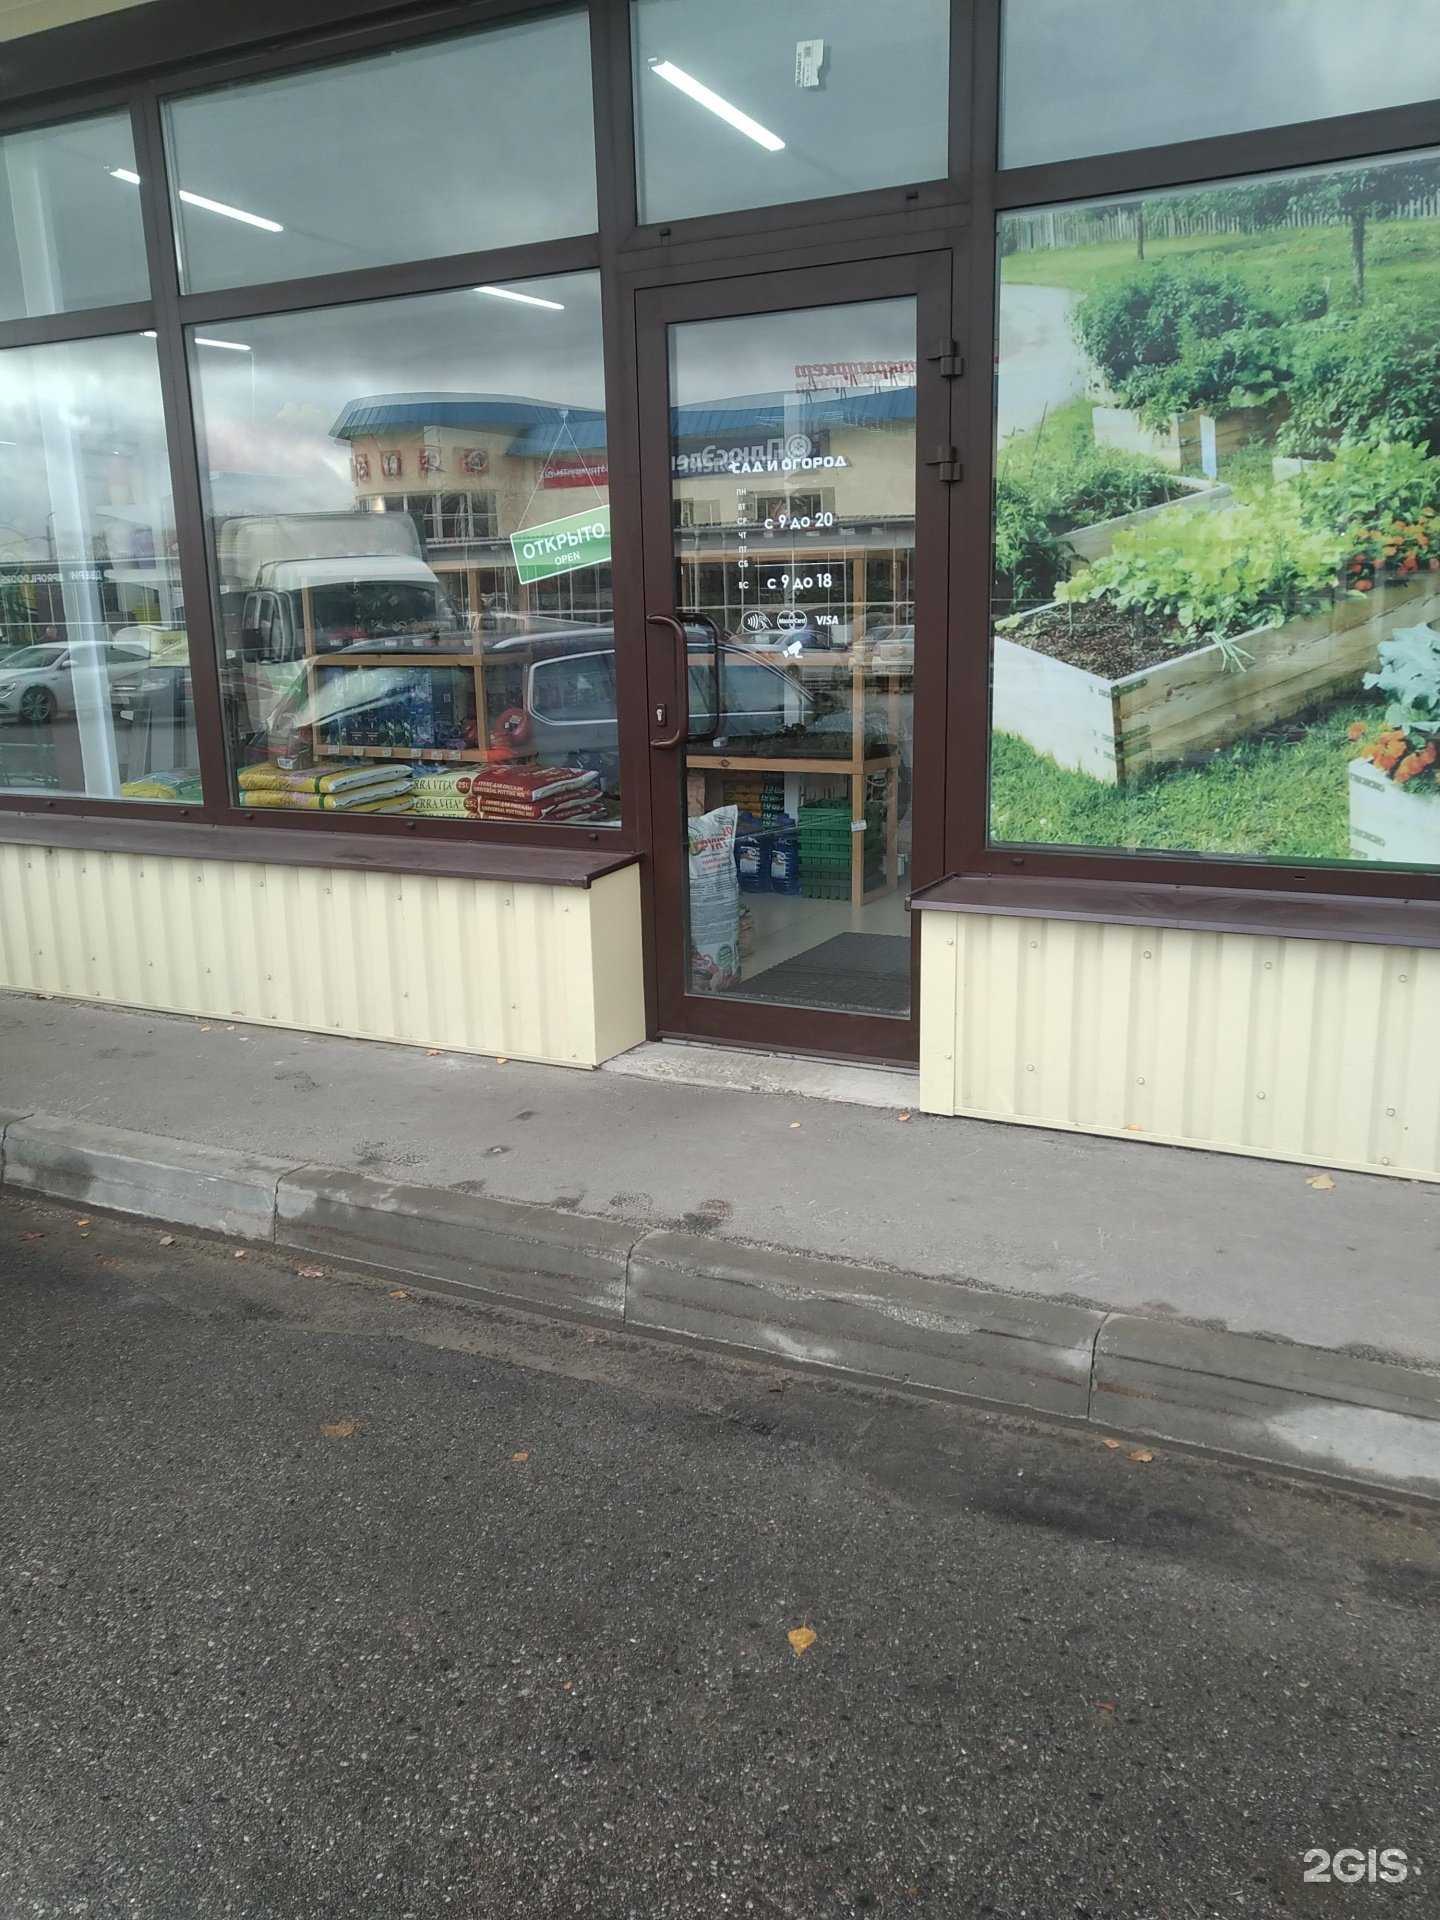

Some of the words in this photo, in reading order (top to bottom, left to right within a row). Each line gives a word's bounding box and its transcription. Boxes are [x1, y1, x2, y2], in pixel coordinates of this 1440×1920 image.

[732, 461, 764, 474] САД
[767, 460, 778, 472] И
[782, 455, 847, 471] ОГОРОД
[778, 514, 787, 529] 9
[815, 511, 833, 528] 20
[522, 522, 606, 560] ОТКРЫТО
[554, 551, 582, 566] OPEN
[781, 574, 790, 589] 9
[816, 573, 832, 588] 18
[815, 615, 839, 626] VISA
